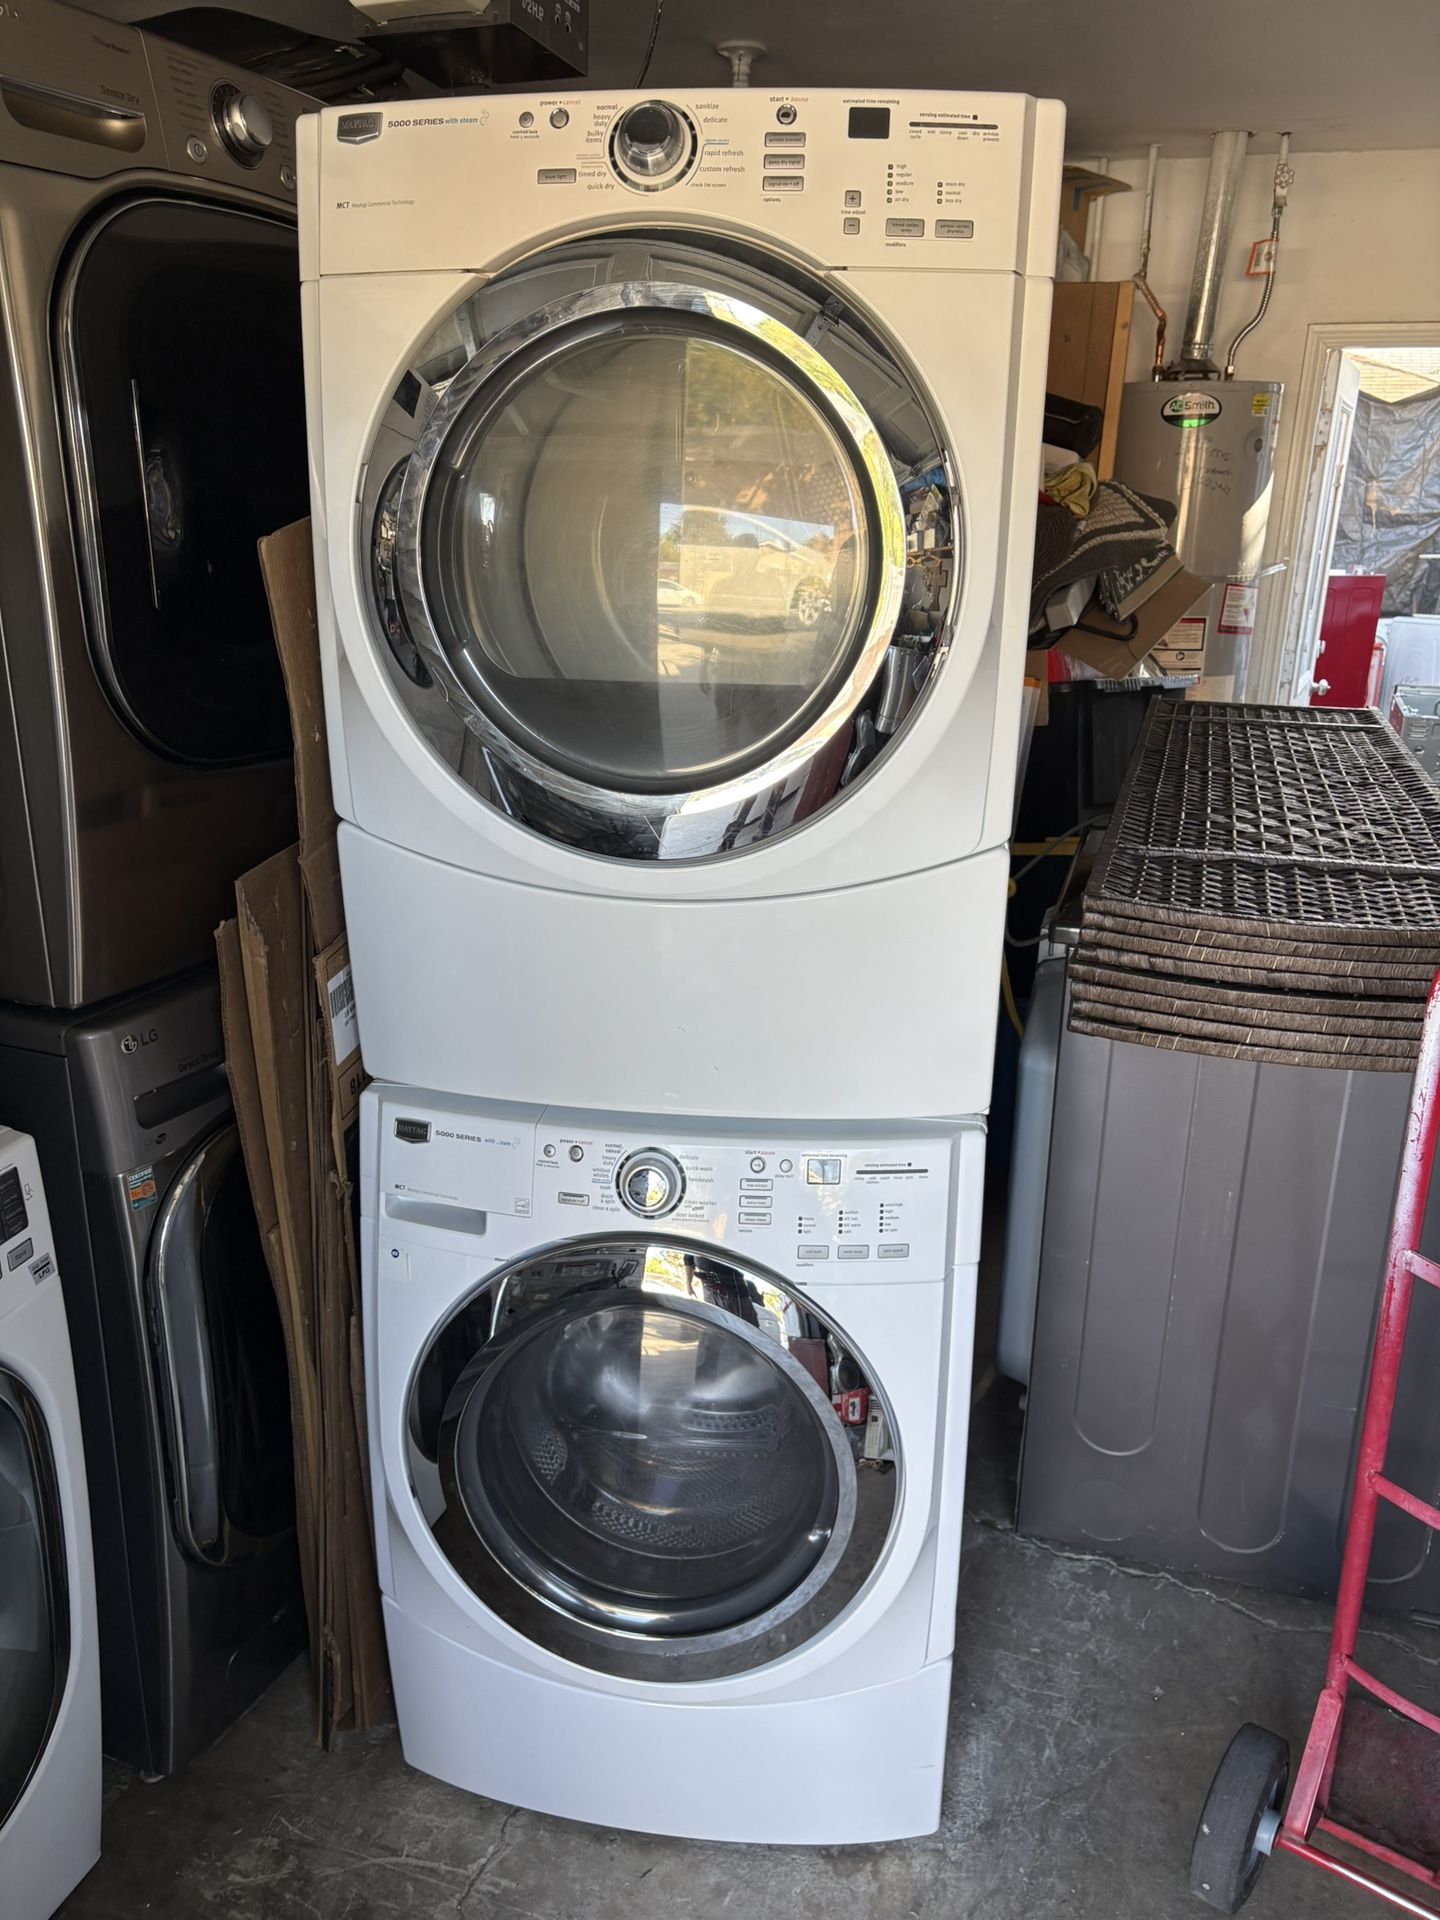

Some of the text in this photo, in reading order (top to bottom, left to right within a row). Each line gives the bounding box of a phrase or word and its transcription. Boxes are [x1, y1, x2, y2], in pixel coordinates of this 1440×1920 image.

[413, 118, 444, 126] SERIES
[1185, 401, 1215, 410] Smith
[140, 1029, 158, 1046] LG
[398, 1124, 426, 1135] MAYTAG
[436, 1130, 454, 1138] 5000
[456, 1134, 481, 1142] SERIES
